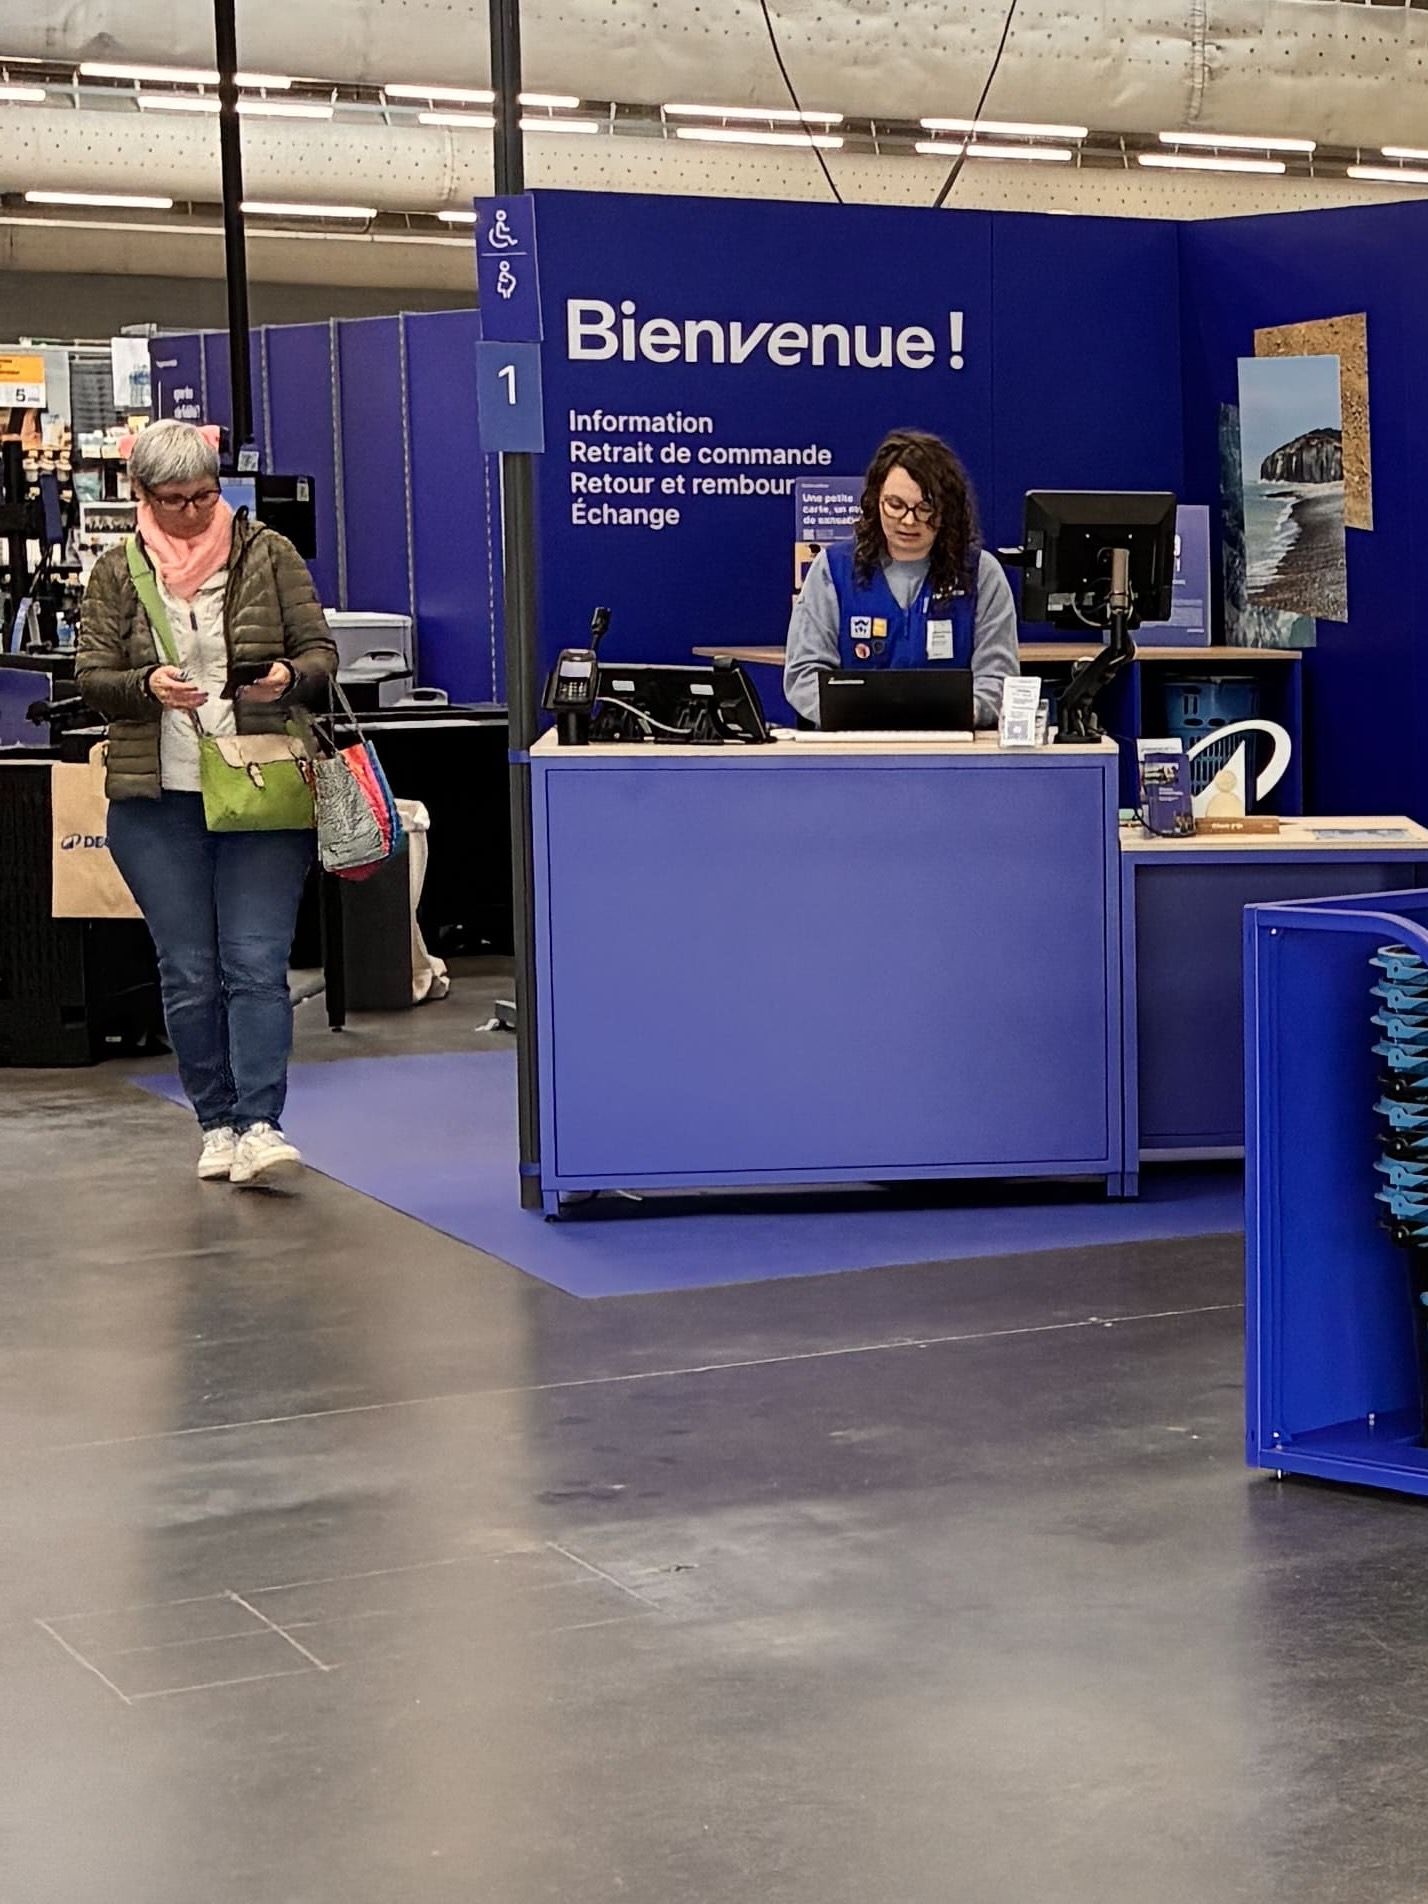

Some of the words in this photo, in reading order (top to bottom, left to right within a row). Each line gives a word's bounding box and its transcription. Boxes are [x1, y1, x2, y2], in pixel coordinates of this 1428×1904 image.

[498, 365, 518, 405] 1
[568, 410, 714, 434] Information
[570, 441, 654, 464] Retrait
[660, 442, 692, 464] de
[698, 444, 832, 465] commande
[571, 472, 655, 494] Retour
[661, 474, 686, 495] et
[692, 474, 796, 496] rembour
[571, 497, 681, 530] Échange
